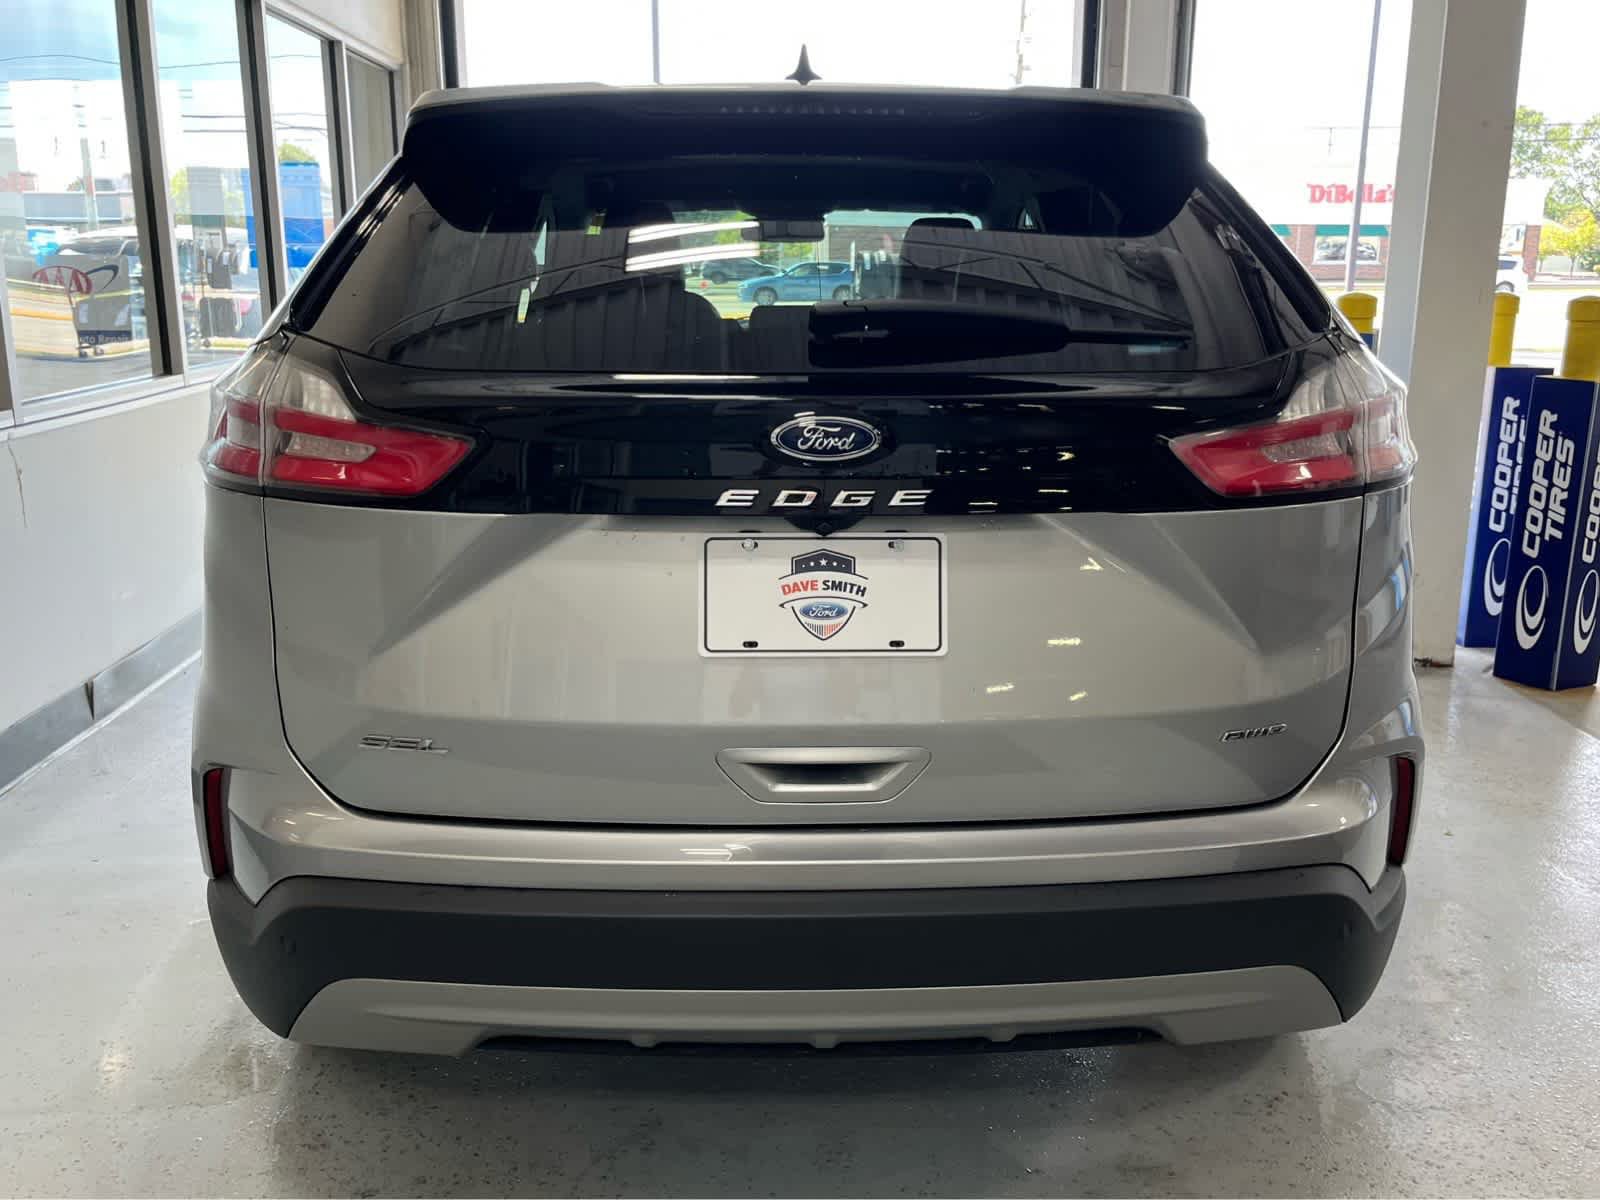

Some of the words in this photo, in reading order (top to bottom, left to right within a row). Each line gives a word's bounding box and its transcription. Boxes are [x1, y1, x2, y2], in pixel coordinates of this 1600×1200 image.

[797, 425, 856, 450] Ford
[1488, 396, 1520, 533] COOPER
[1521, 408, 1558, 559] COOPER
[1544, 433, 1575, 541] TIRES
[715, 489, 933, 507] EDGE
[781, 580, 818, 596] DAVE
[822, 580, 867, 597] SMITH
[809, 604, 840, 617] Ford
[359, 736, 448, 753] SEL
